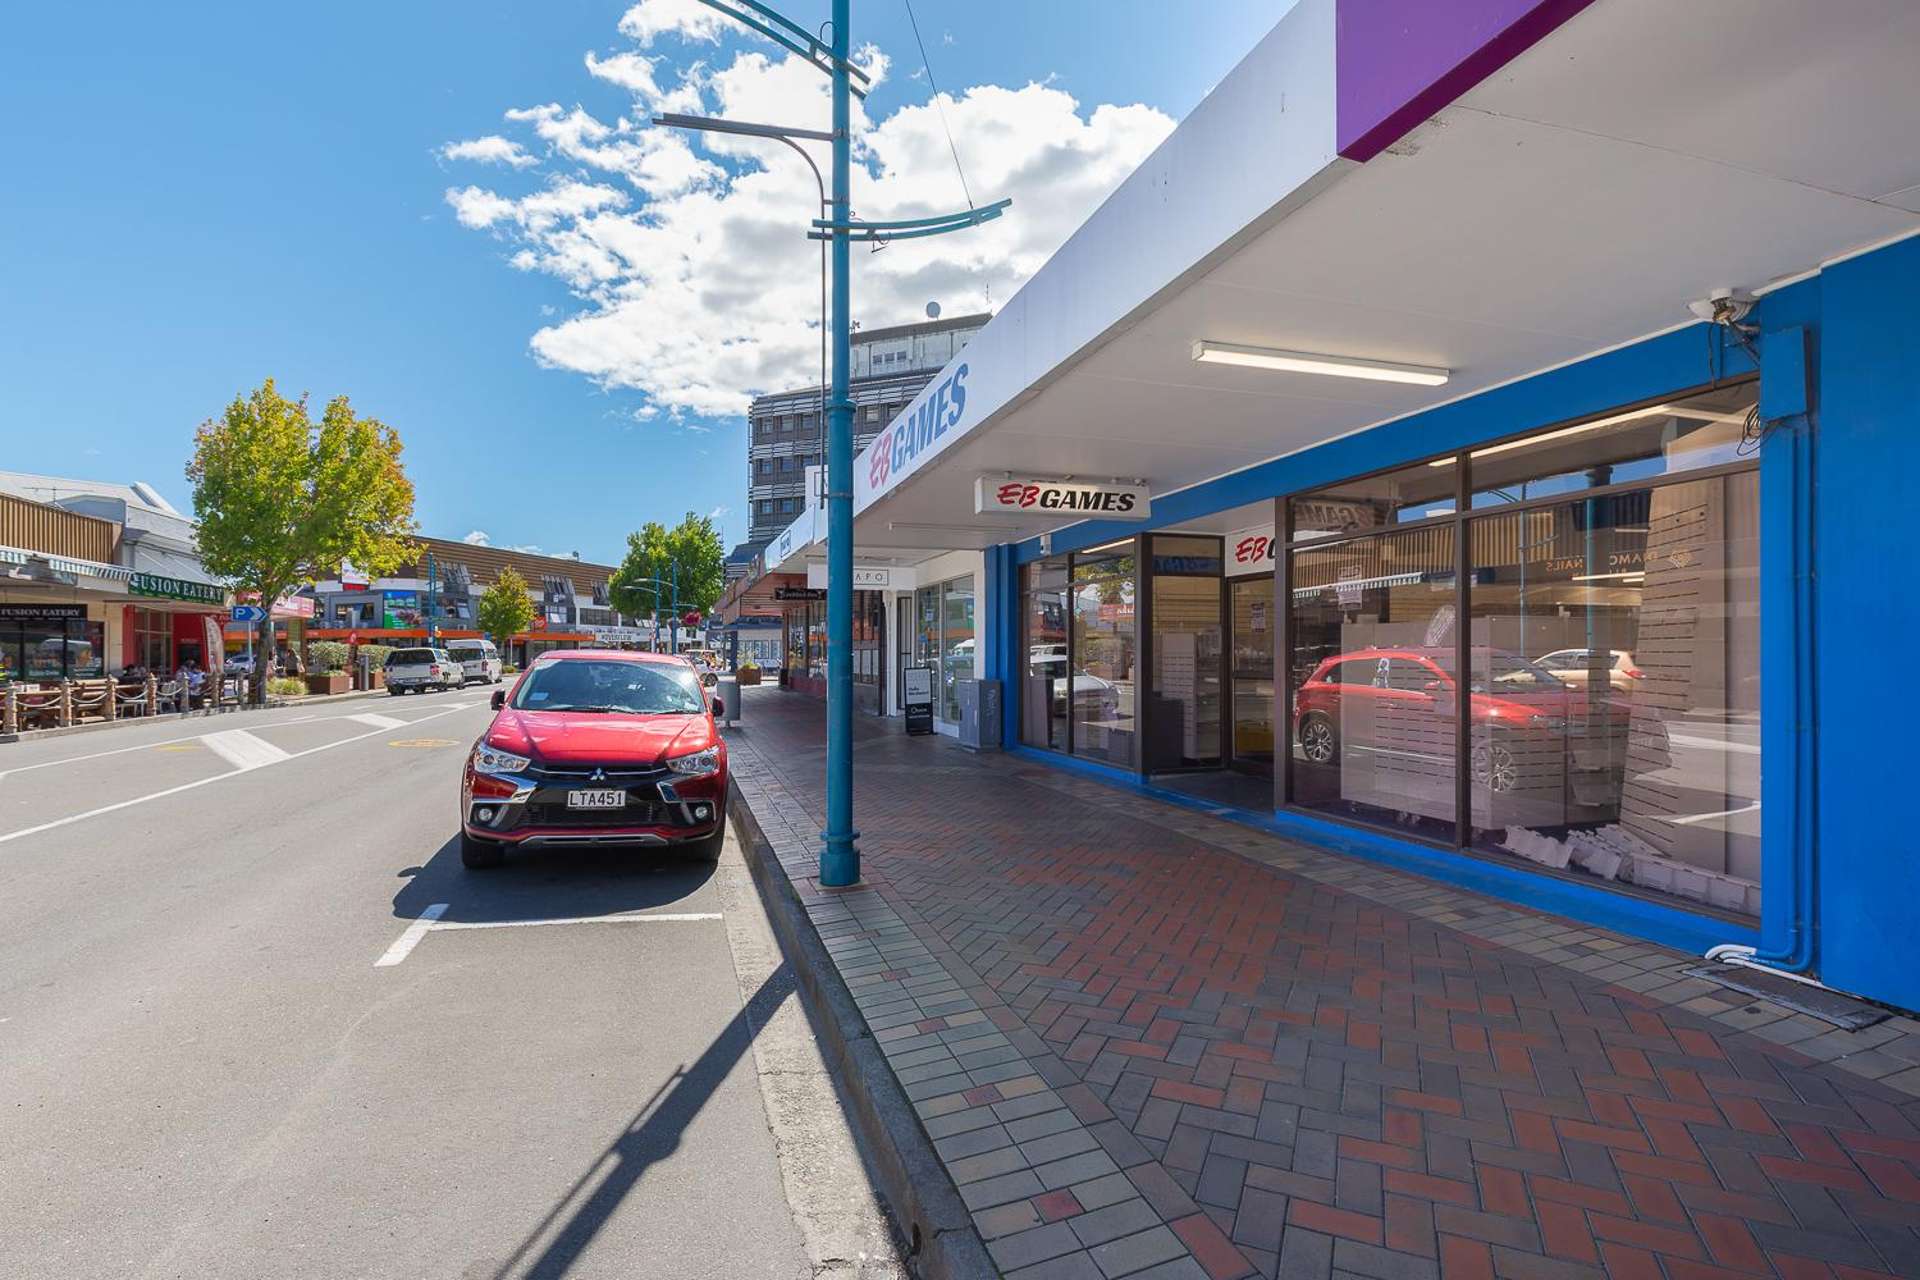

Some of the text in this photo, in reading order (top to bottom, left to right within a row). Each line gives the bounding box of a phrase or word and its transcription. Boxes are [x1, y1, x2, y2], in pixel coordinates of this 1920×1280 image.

[1039, 487, 1137, 512] GAMES
[855, 572, 883, 582] APO
[183, 583, 223, 601] EATERY
[1, 607, 81, 617] FUSION EATERY
[235, 608, 245, 618] P
[570, 792, 622, 806] LTA451
